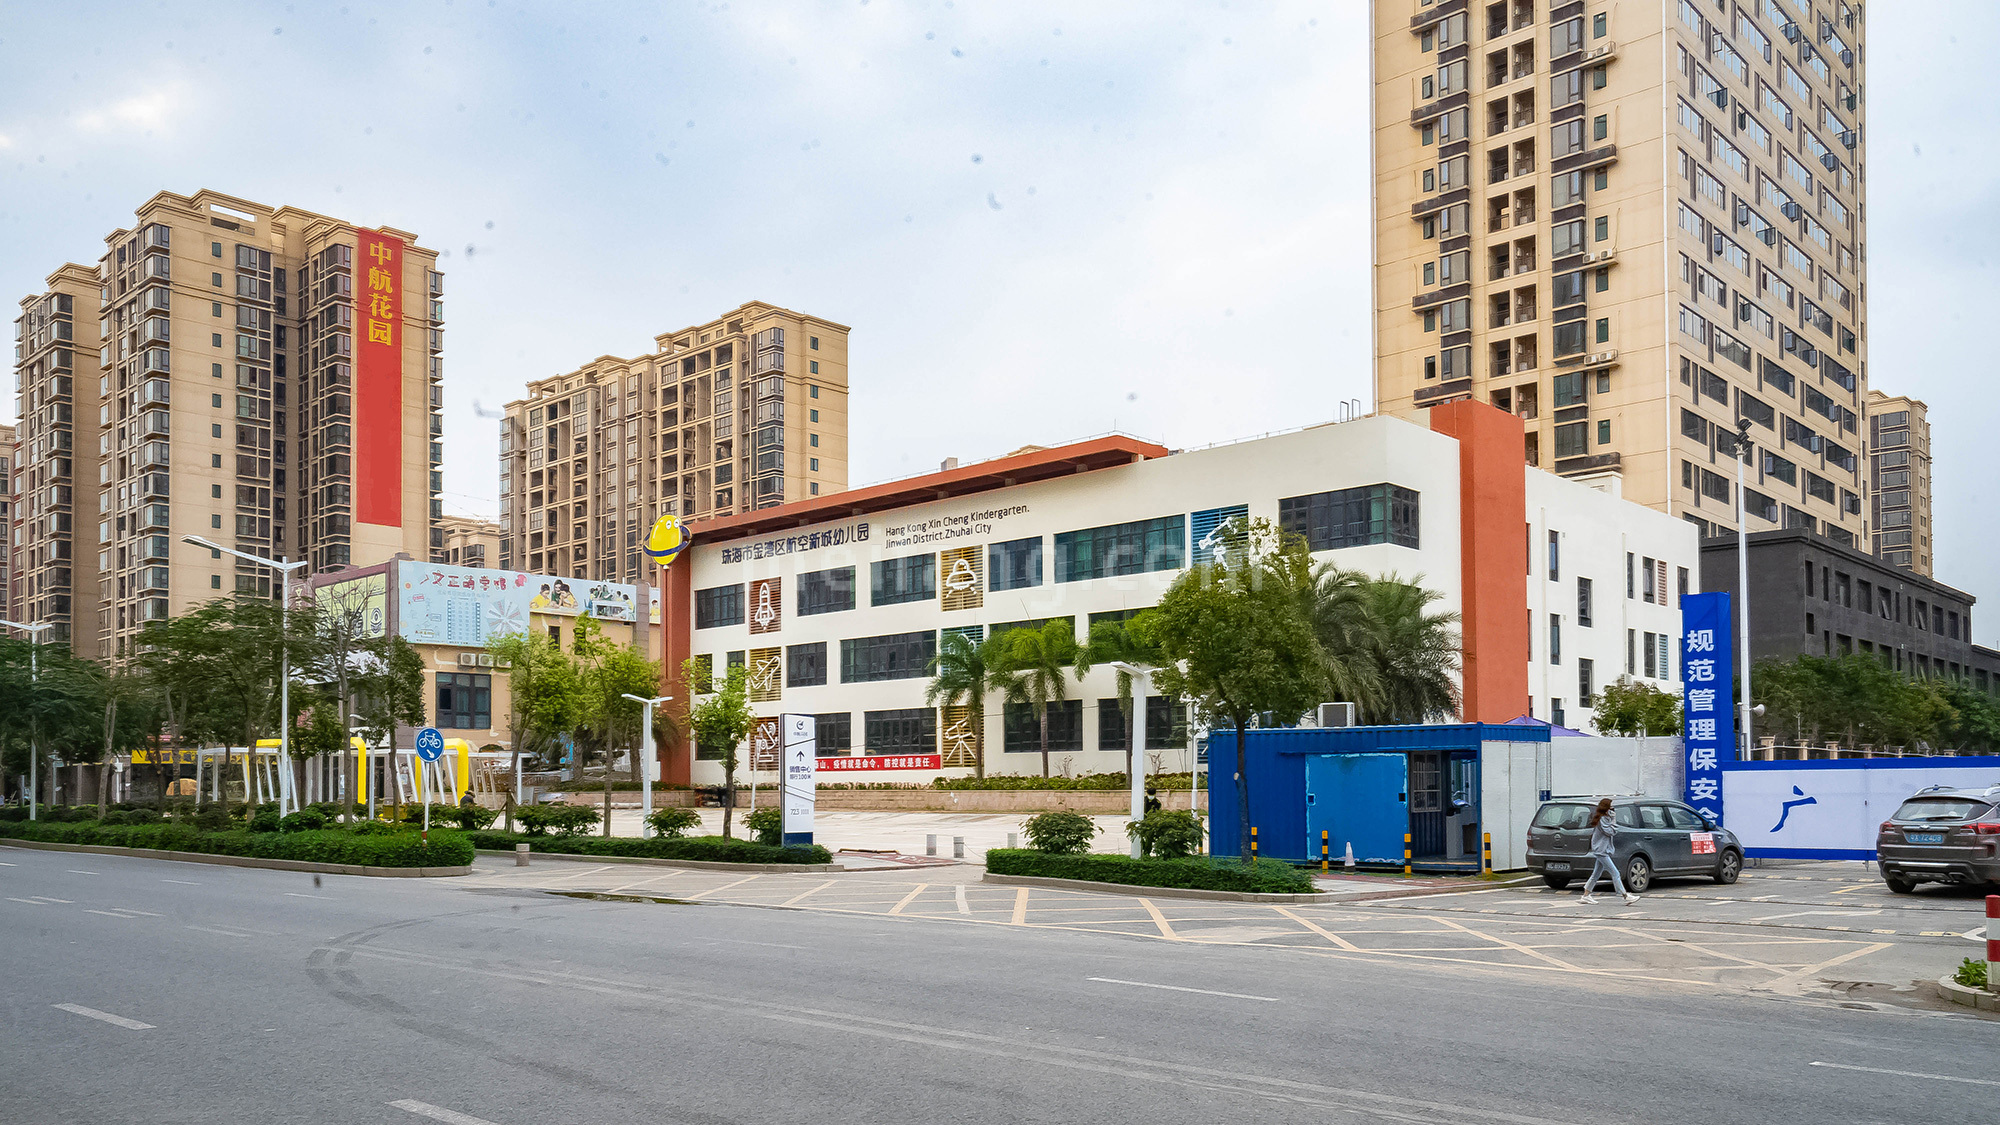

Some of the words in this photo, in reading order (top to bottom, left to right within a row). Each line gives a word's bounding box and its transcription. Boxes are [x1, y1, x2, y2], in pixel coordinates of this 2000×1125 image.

[368, 241, 393, 346] 中航花园
[885, 536, 912, 549] Jinwan
[975, 523, 992, 534] City
[886, 526, 905, 537] Hang
[907, 522, 927, 533] Kong
[928, 519, 941, 529] Xin
[943, 515, 969, 527] Cheng
[970, 505, 1030, 521] Kindergarten.
[721, 523, 870, 565] 珠海市金湾区航空新城幼儿园
